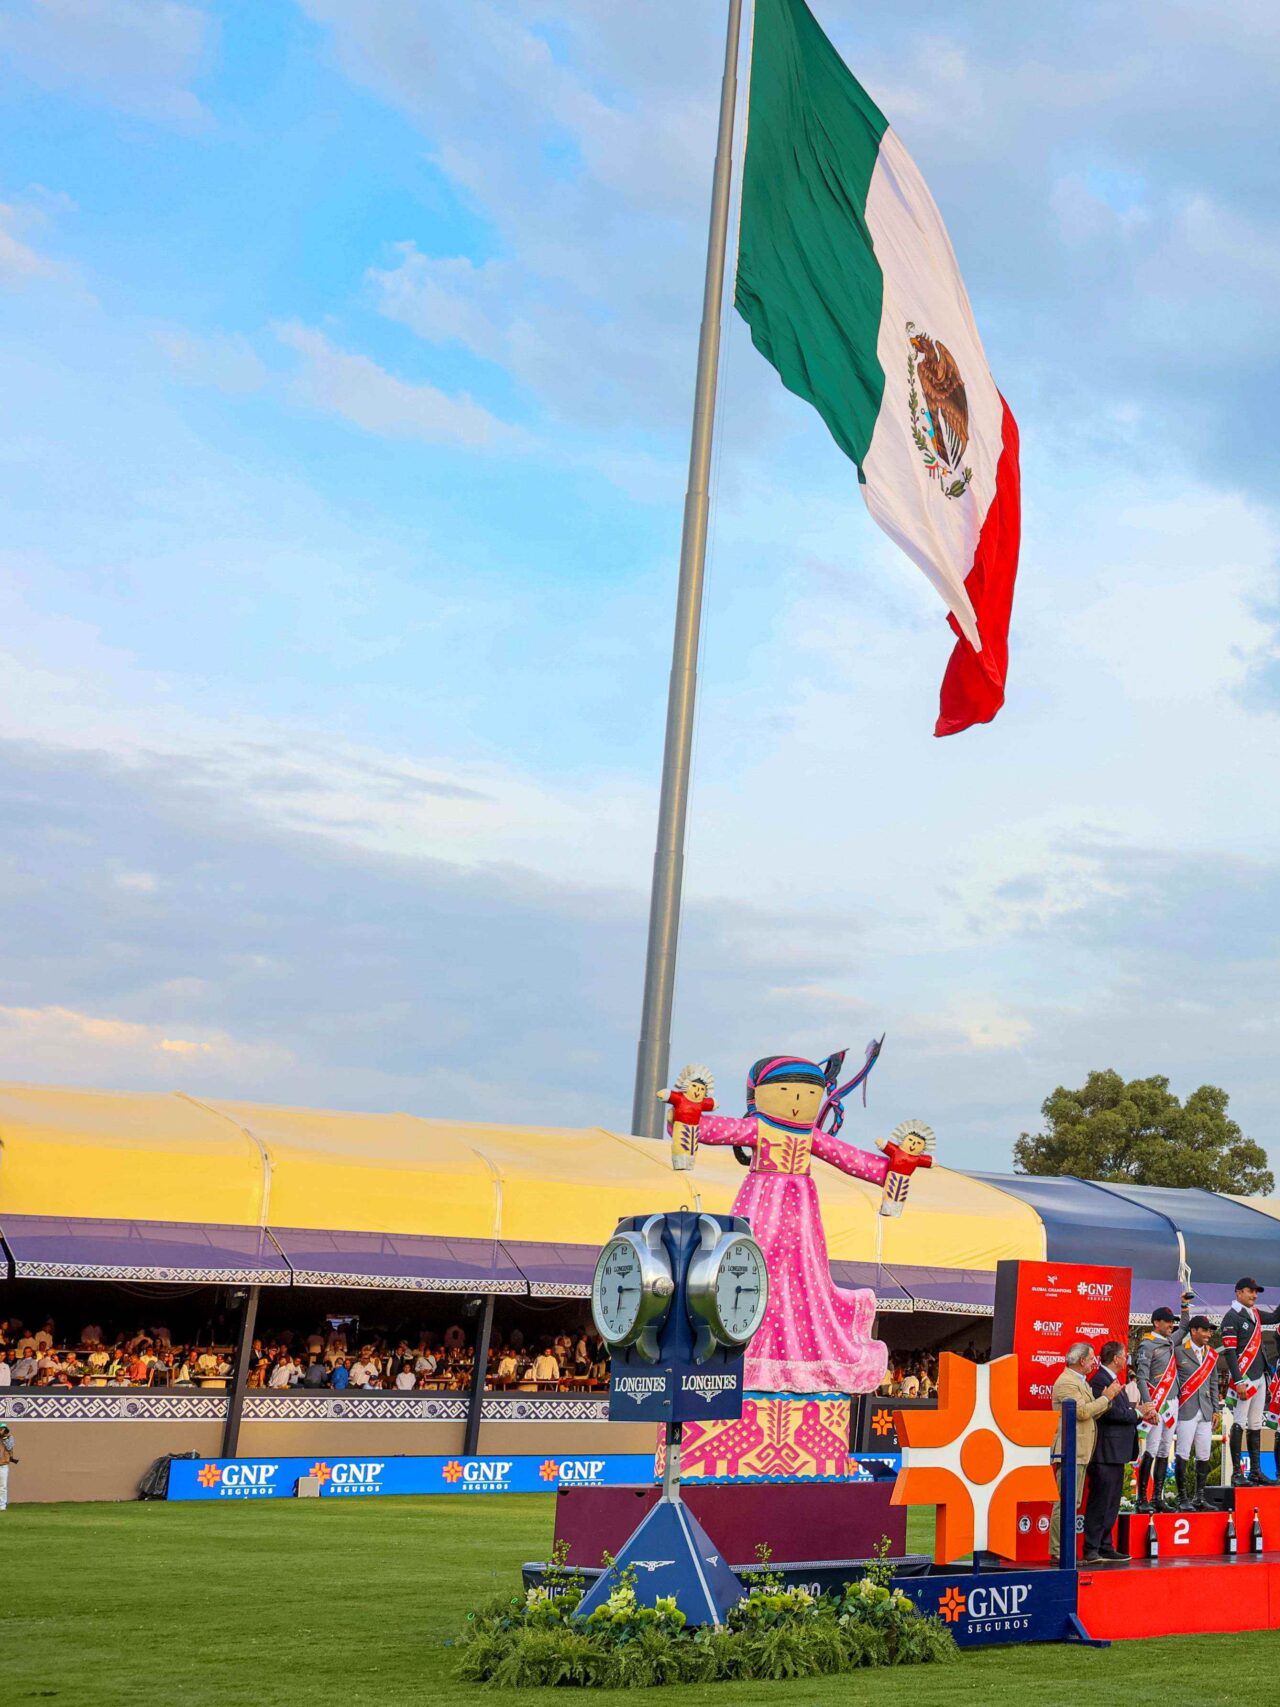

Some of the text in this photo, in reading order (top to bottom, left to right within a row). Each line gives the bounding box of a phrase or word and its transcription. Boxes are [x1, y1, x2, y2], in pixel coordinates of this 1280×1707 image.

[1088, 1284, 1112, 1296] GNP
[1042, 1322, 1062, 1331] GNP
[614, 1377, 666, 1392] LONGINES
[682, 1375, 736, 1390] LONGINES
[222, 1464, 276, 1485] GNP
[331, 1463, 382, 1483] GNP
[463, 1462, 510, 1481] GNP
[559, 1461, 603, 1480] GNP
[220, 1488, 273, 1496] SEGUROS
[330, 1485, 380, 1493] SEGUROS
[1174, 1518, 1190, 1544] 2
[968, 1584, 1028, 1618] GNP
[968, 1620, 1028, 1634] SEGUROS
